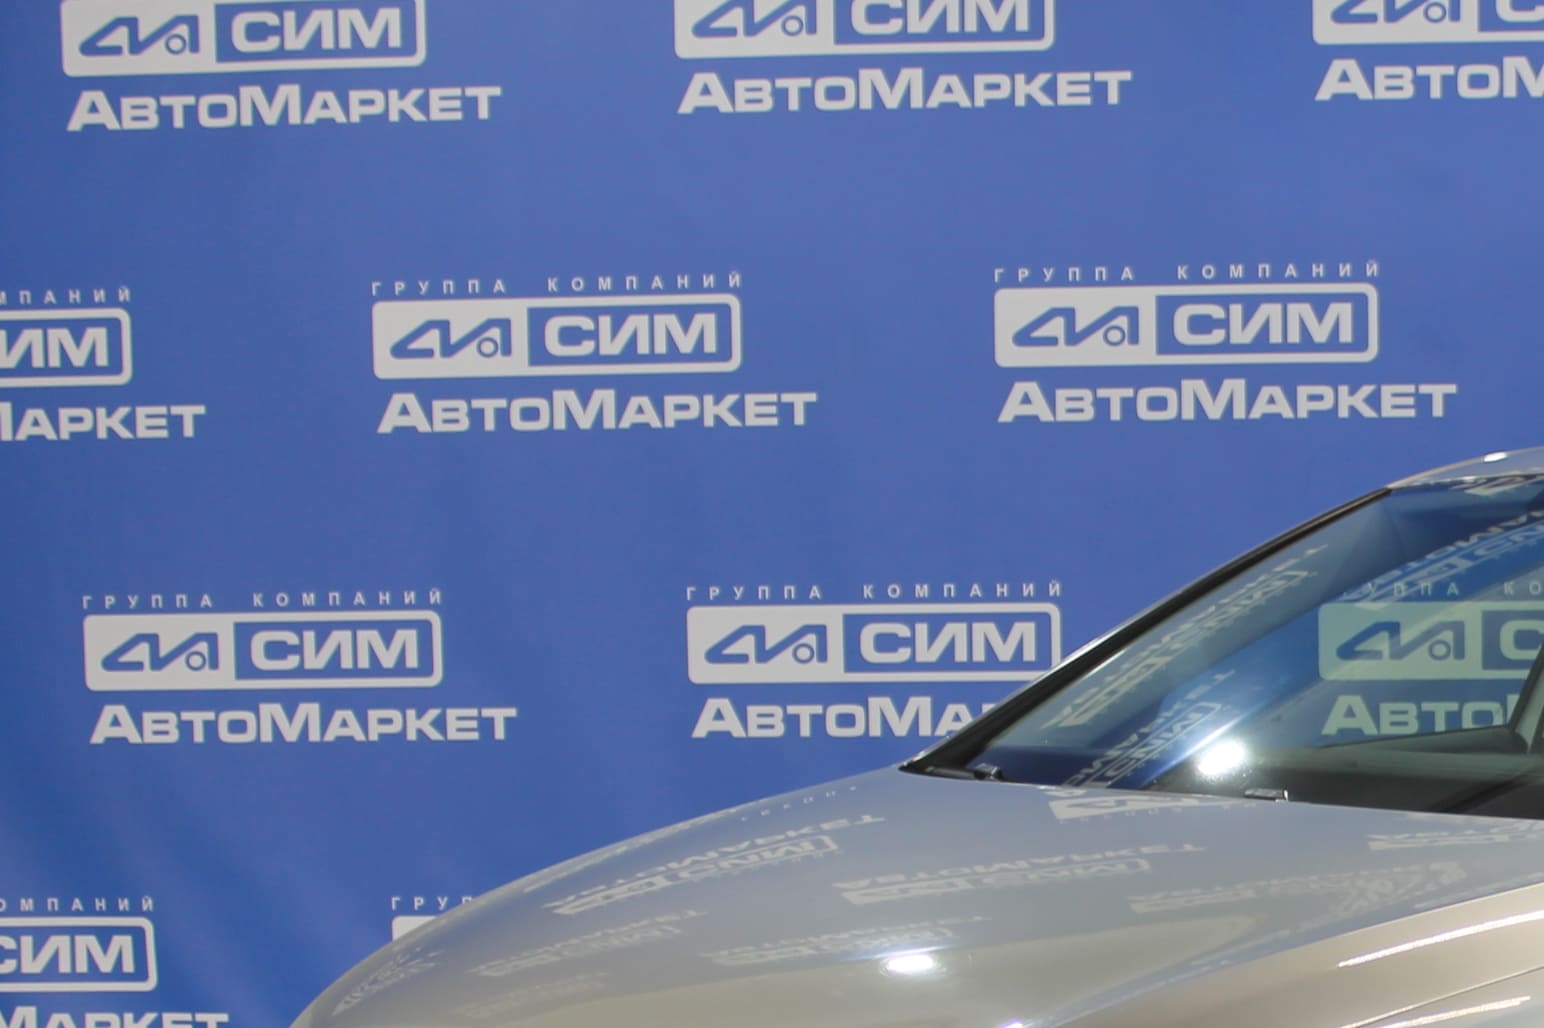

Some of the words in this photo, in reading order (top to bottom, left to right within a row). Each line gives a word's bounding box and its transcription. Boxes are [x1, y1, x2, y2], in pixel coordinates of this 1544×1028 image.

[231, 7, 401, 54] СИМ
[371, 278, 505, 296] ГРУППА
[547, 271, 741, 293] КОМПАНИЙ
[994, 266, 1133, 283] ГРУППА
[1177, 260, 1378, 280] КОМПАНИЙ
[544, 312, 717, 357] СИМ
[1173, 302, 1353, 345] СИМ
[82, 593, 212, 609] ГРУППА
[252, 588, 441, 607] КОМПАНИЙ
[686, 585, 821, 601] ГРУППА
[863, 579, 1061, 599] КОМПАНИЙ
[250, 628, 418, 671] СИМ
[859, 621, 1036, 664] СИМ
